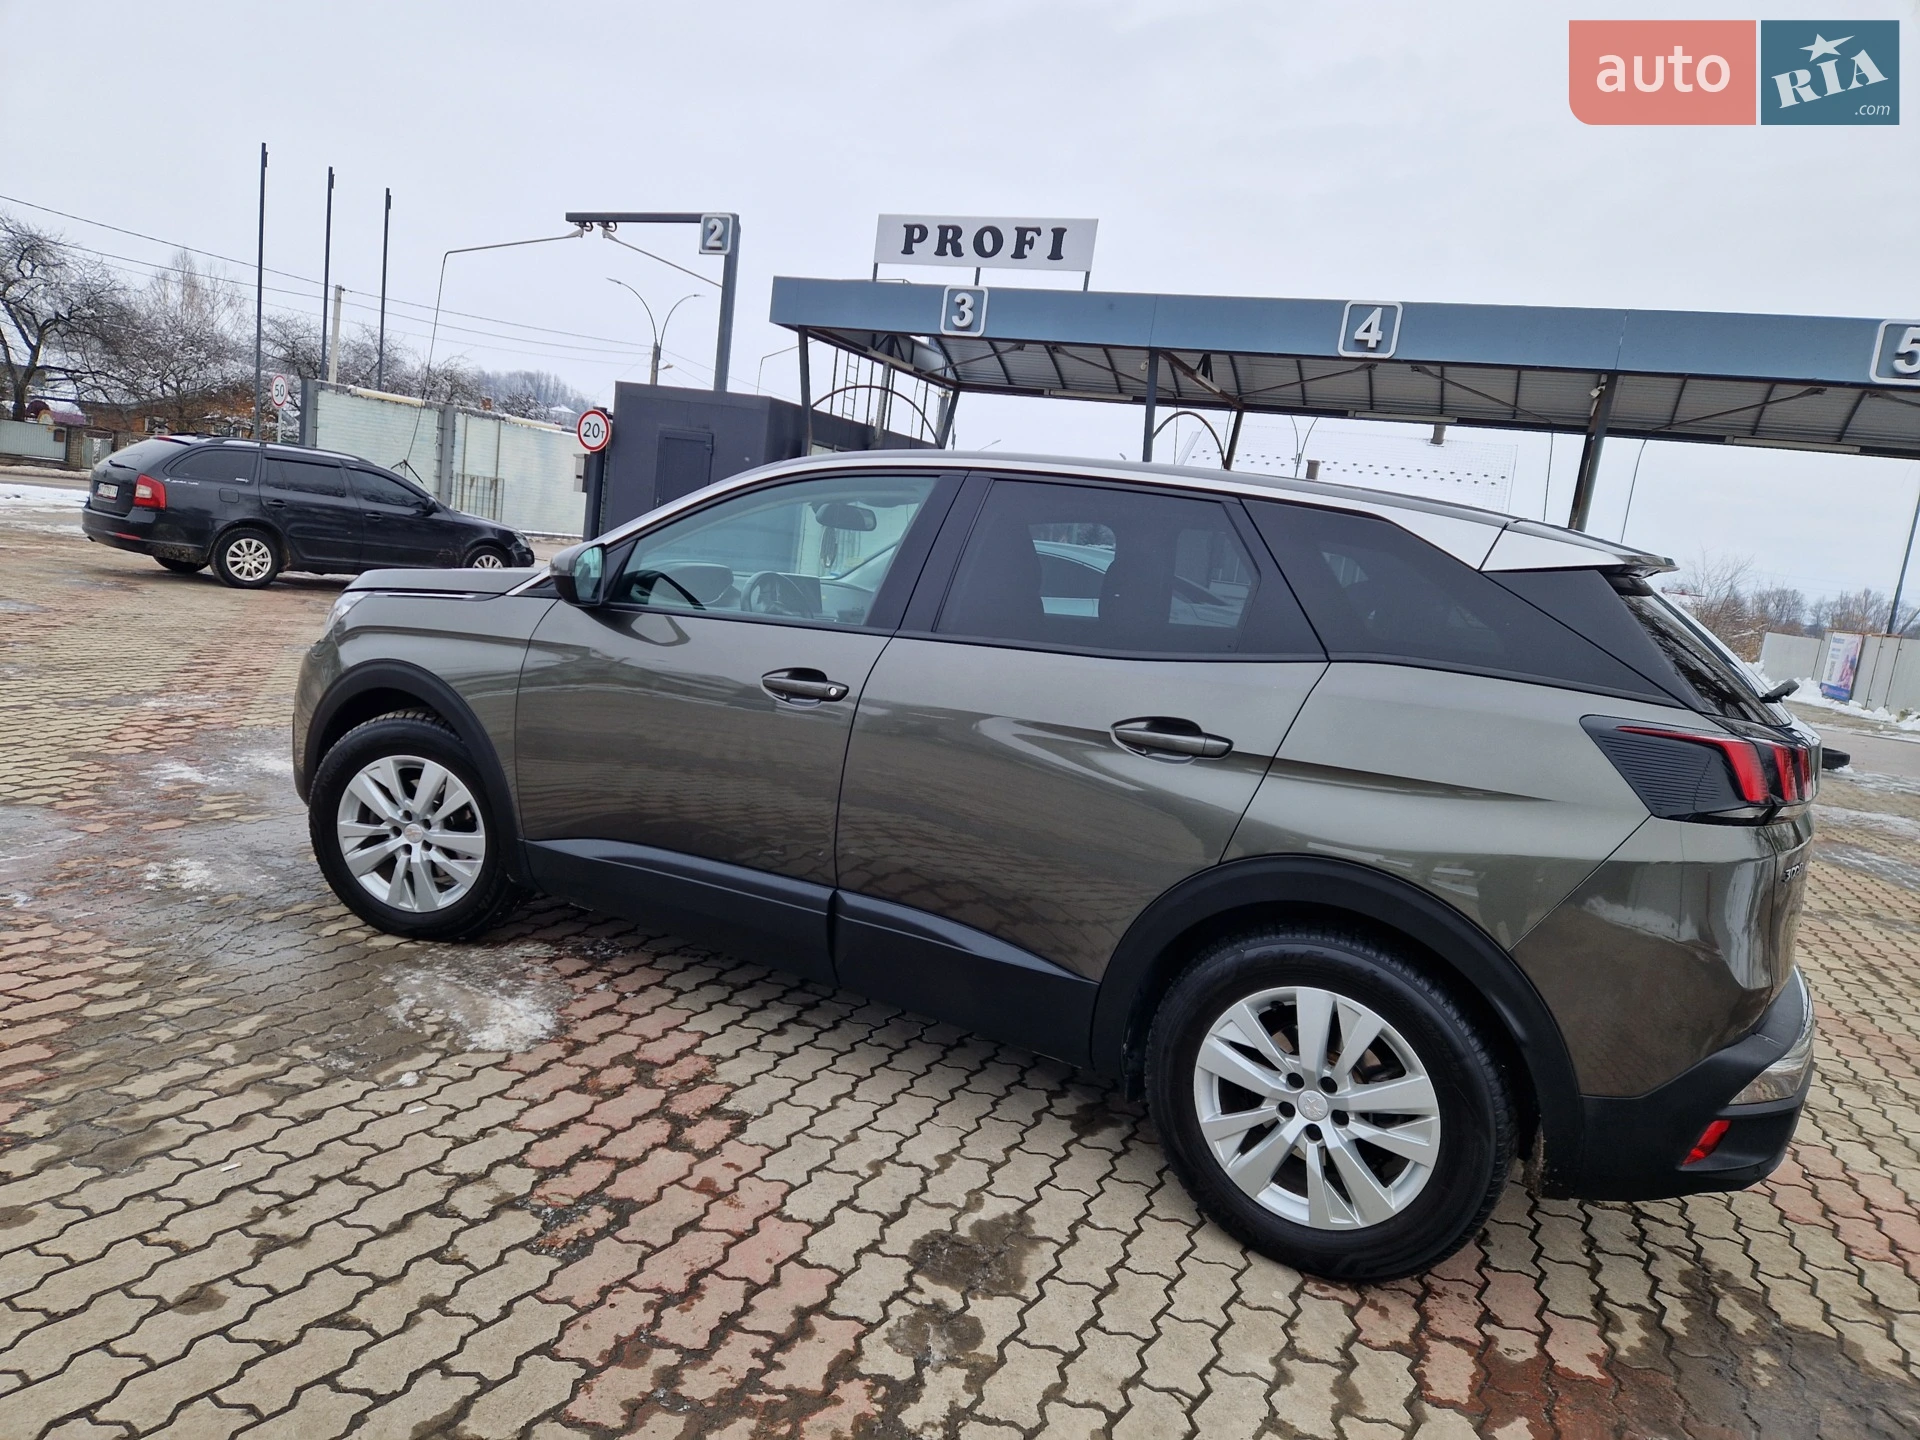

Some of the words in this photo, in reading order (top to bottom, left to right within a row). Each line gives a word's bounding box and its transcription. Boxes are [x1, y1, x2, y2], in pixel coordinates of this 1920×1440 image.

[704, 217, 725, 249] 2
[901, 222, 1068, 261] PROFI
[951, 291, 975, 329] 3
[1353, 307, 1384, 349] 4
[1893, 326, 1920, 375] 5
[274, 383, 285, 398] 50
